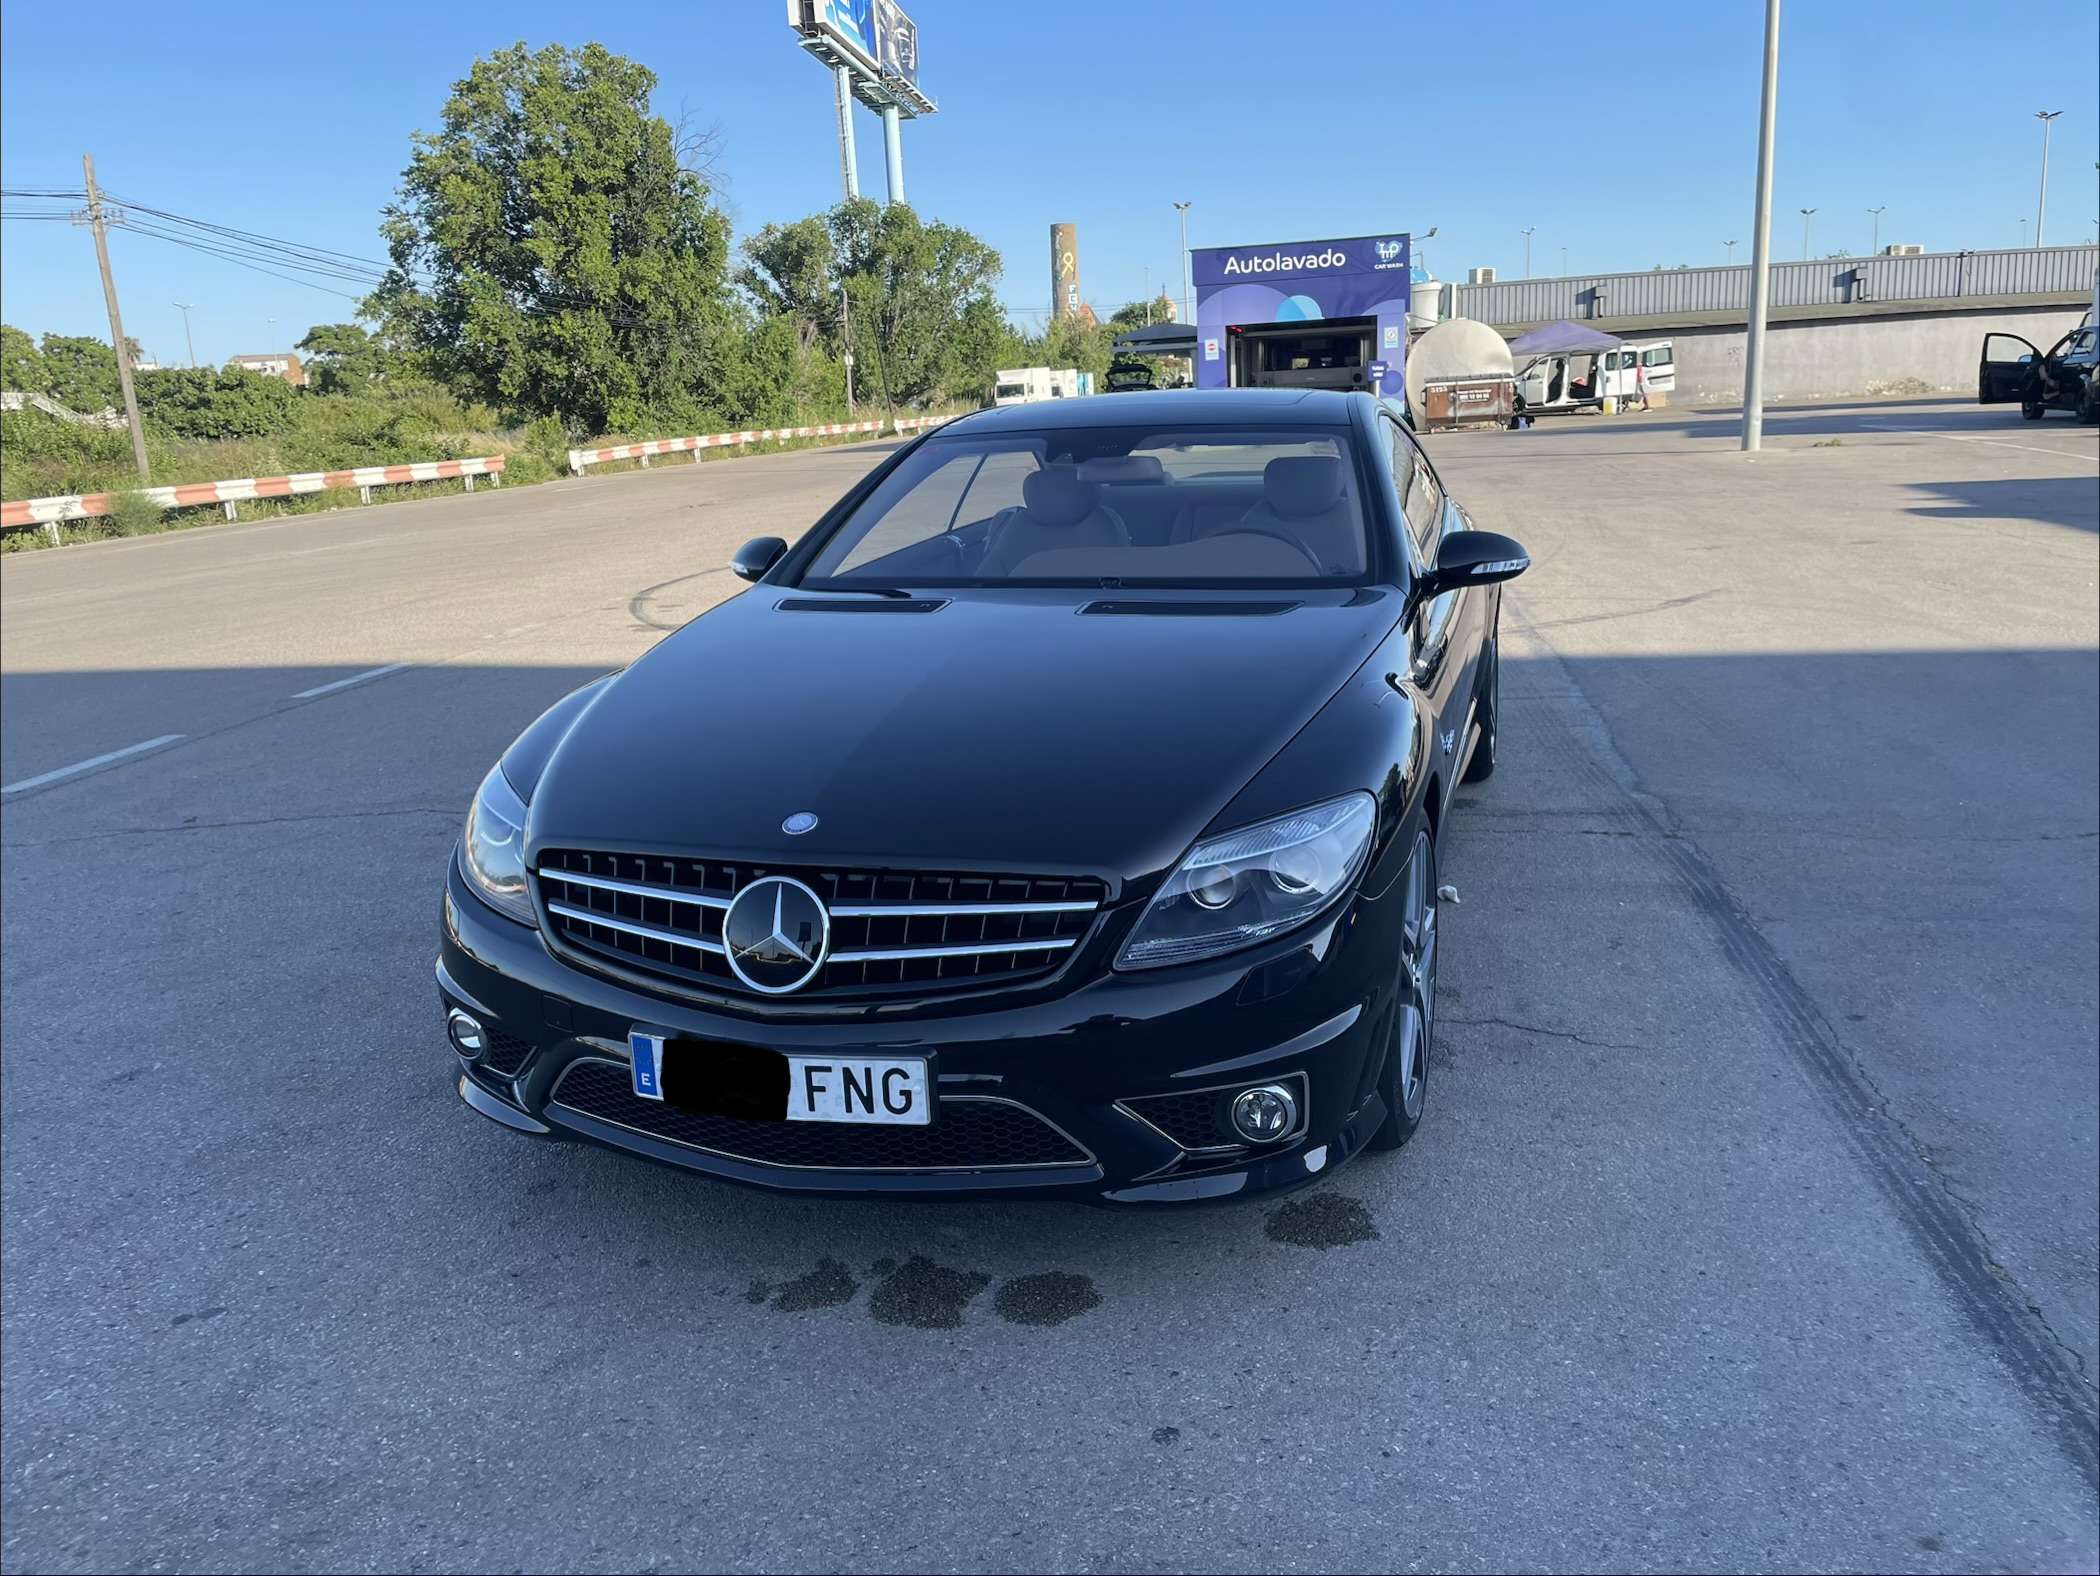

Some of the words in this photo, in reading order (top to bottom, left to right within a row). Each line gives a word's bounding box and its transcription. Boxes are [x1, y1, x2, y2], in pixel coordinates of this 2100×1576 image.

[1223, 248, 1346, 275] Autolavado
[641, 1072, 651, 1086] E
[803, 1065, 913, 1115] FNG
